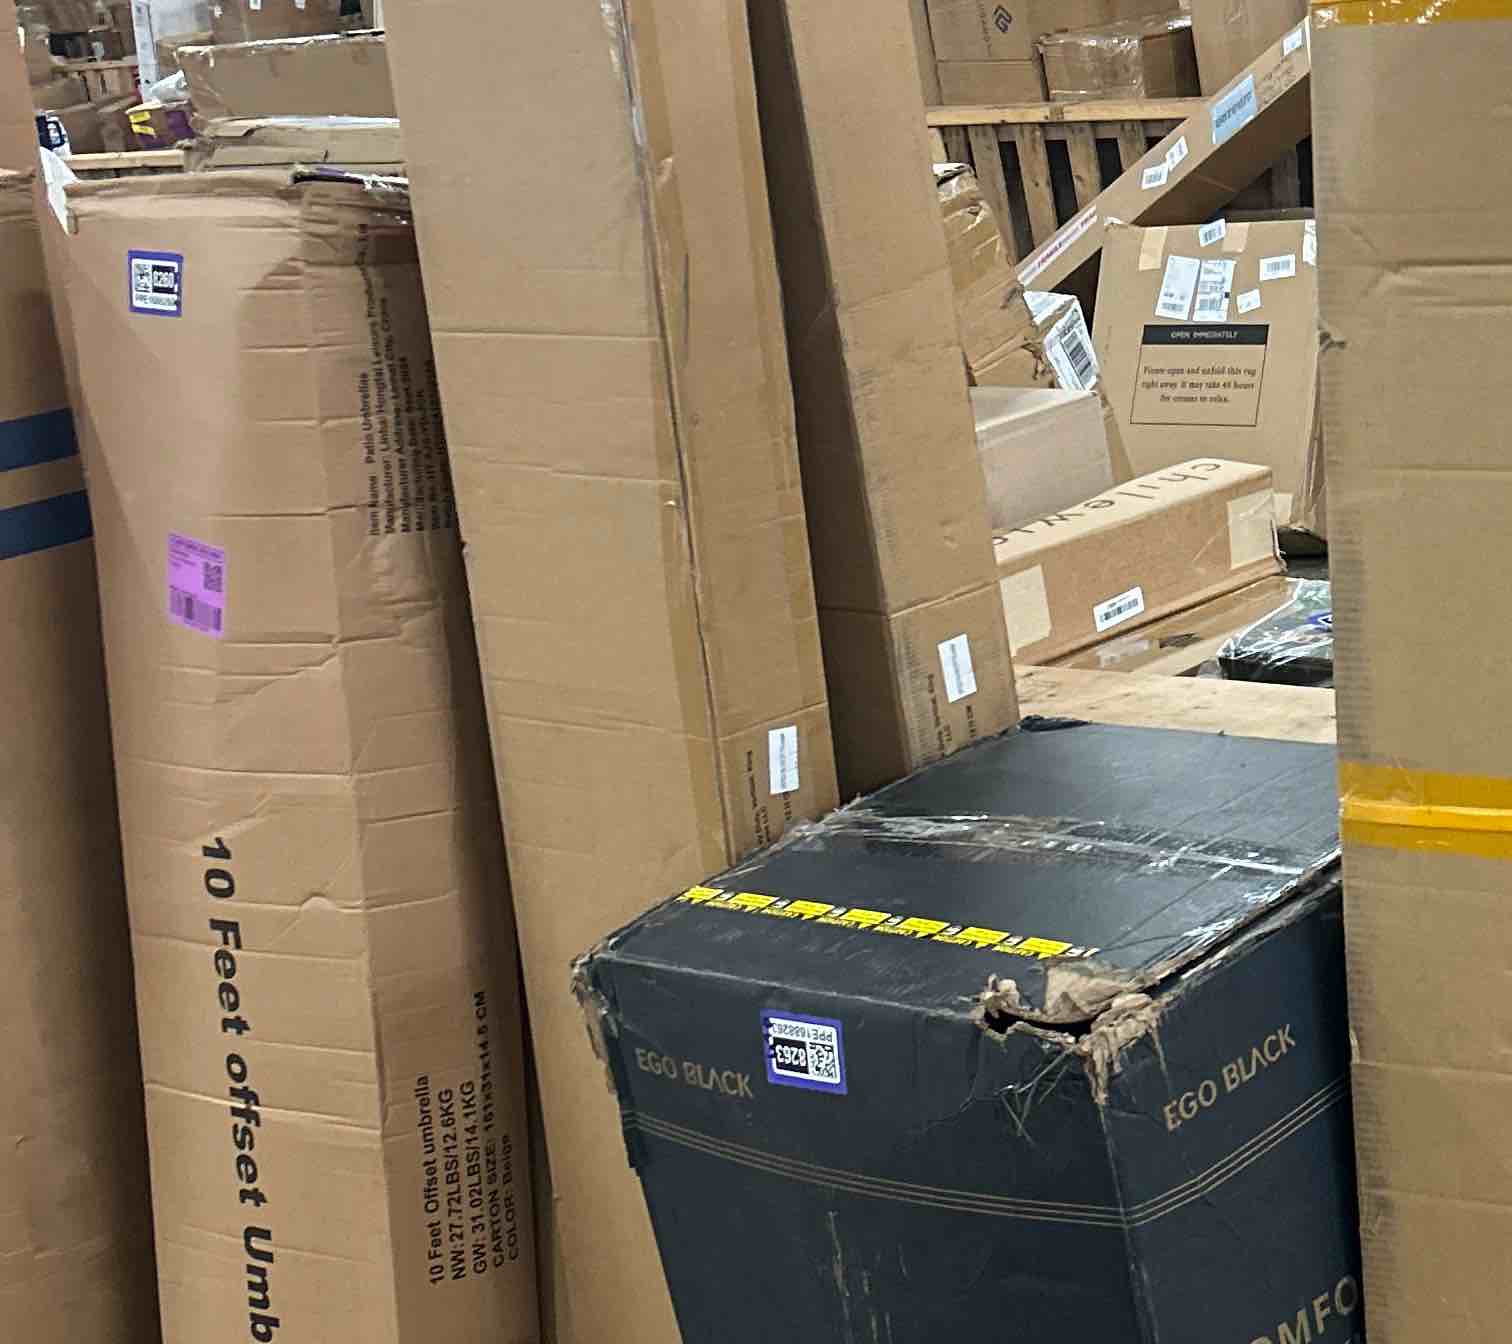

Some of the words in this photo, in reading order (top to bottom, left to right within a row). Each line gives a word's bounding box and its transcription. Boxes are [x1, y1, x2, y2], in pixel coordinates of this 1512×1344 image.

[202, 836, 236, 899] 10
[208, 919, 252, 1036] Feet
[634, 1047, 678, 1079] EGO
[682, 1061, 754, 1099] BLACK
[774, 1044, 807, 1067] 8263
[1163, 1079, 1218, 1133] EGO
[1221, 1023, 1297, 1094] BLACK
[226, 1053, 268, 1207] offset
[413, 1074, 436, 1155] umbrella
[422, 1159, 440, 1214] Offset
[427, 1219, 442, 1261] Feet
[429, 1264, 445, 1285] 10
